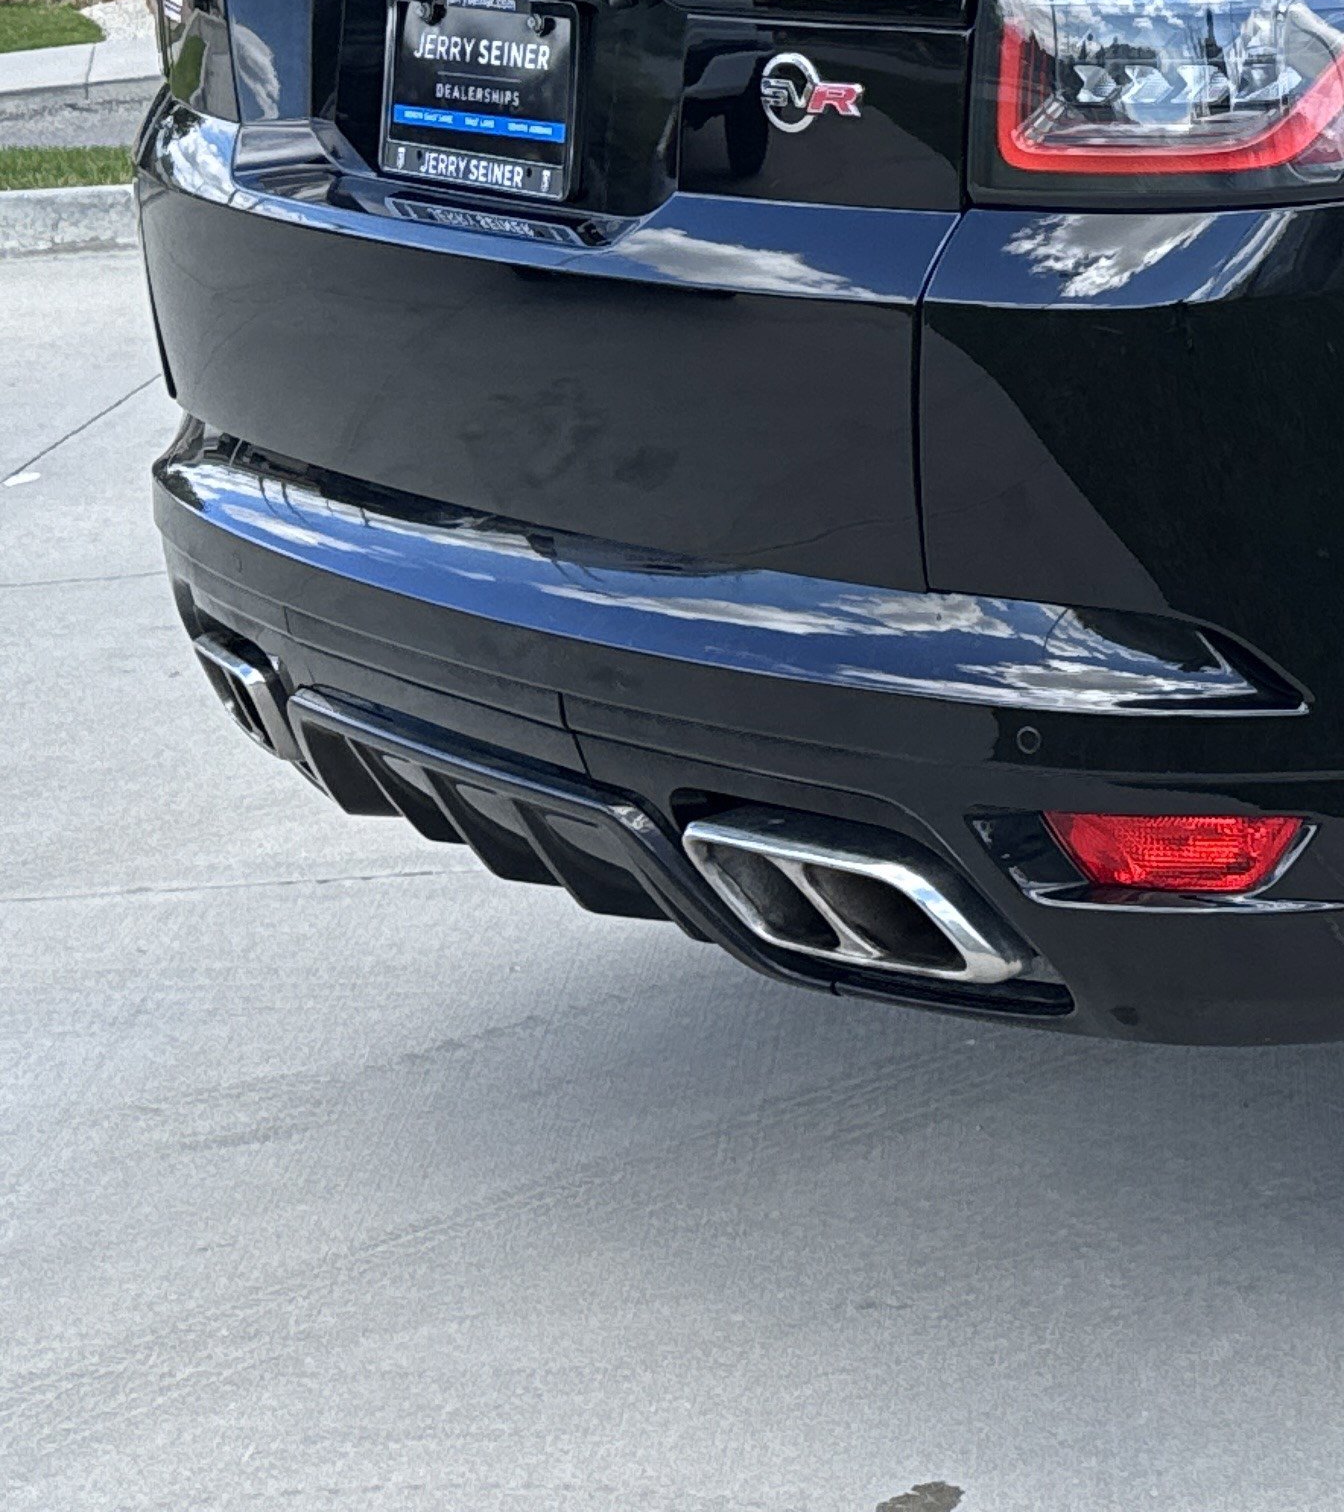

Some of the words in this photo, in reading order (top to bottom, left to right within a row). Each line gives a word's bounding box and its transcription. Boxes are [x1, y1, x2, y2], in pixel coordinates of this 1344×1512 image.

[413, 31, 476, 63] JERRY
[477, 38, 551, 71] SEINER
[435, 82, 520, 107] DEALERSHIPS
[419, 151, 468, 179] JERRY
[468, 158, 525, 189] SEINER
